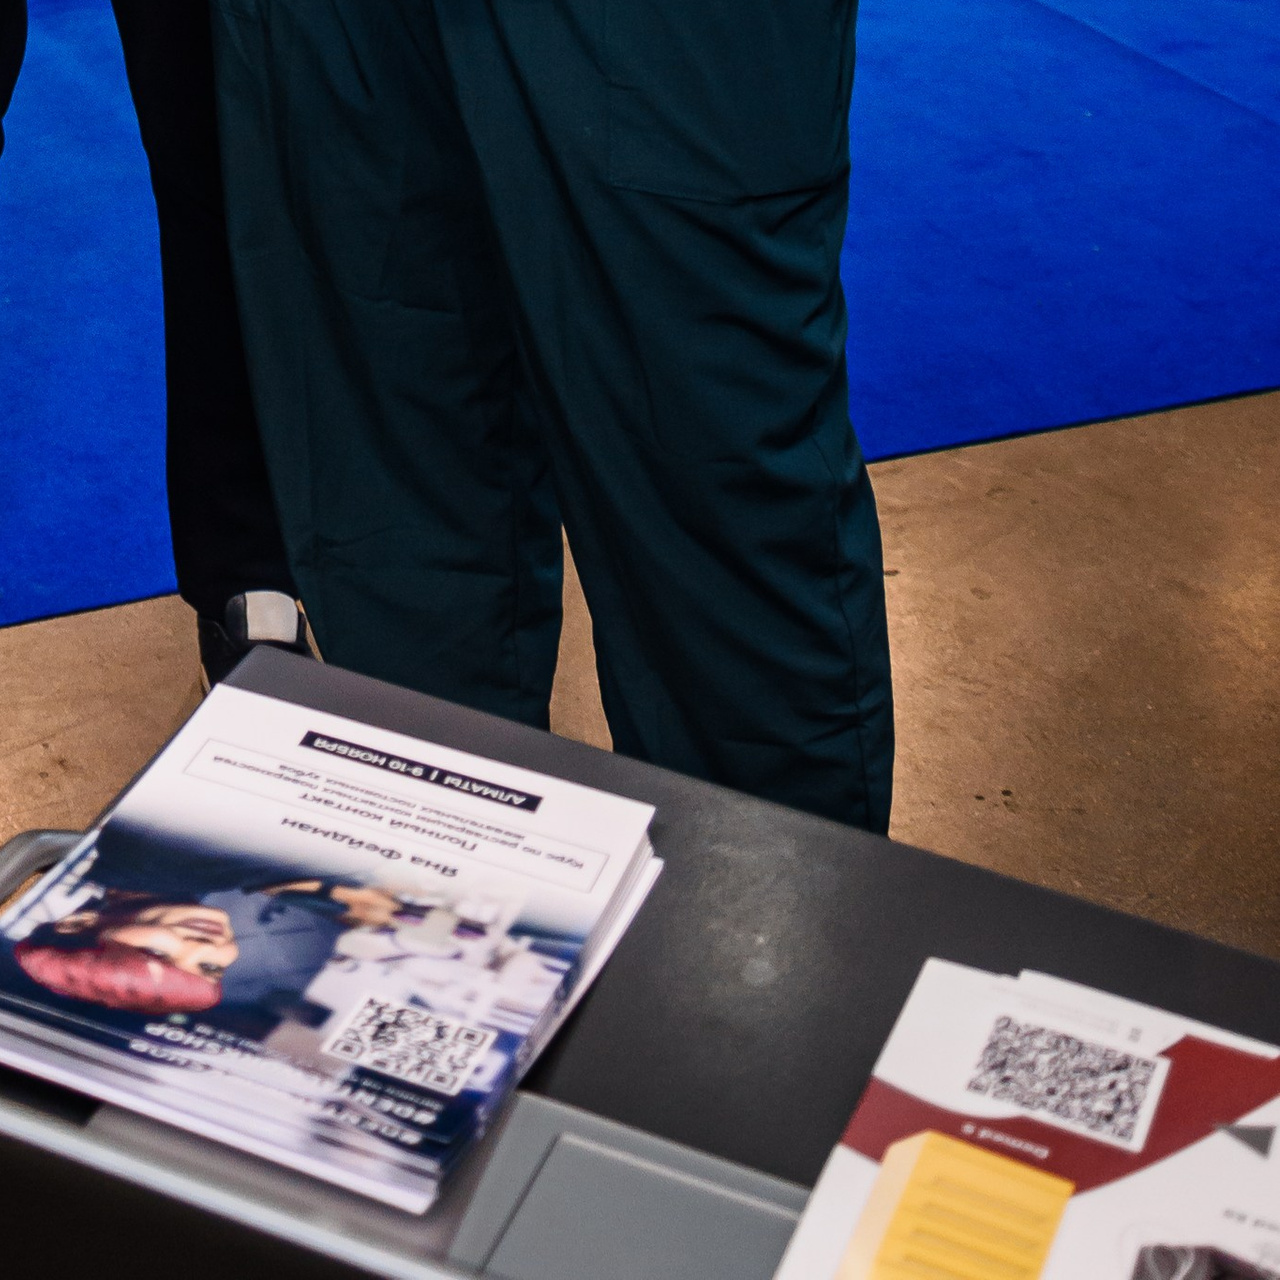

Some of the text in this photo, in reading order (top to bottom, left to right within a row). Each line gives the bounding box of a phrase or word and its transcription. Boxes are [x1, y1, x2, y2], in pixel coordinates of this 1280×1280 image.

[313, 737, 387, 766] НОЯБРЯ
[389, 759, 423, 777] 9-10
[443, 777, 527, 805] АЛМАТЫ
[298, 792, 479, 852] Полный контакт
[280, 817, 460, 878] Яна Фейдман
